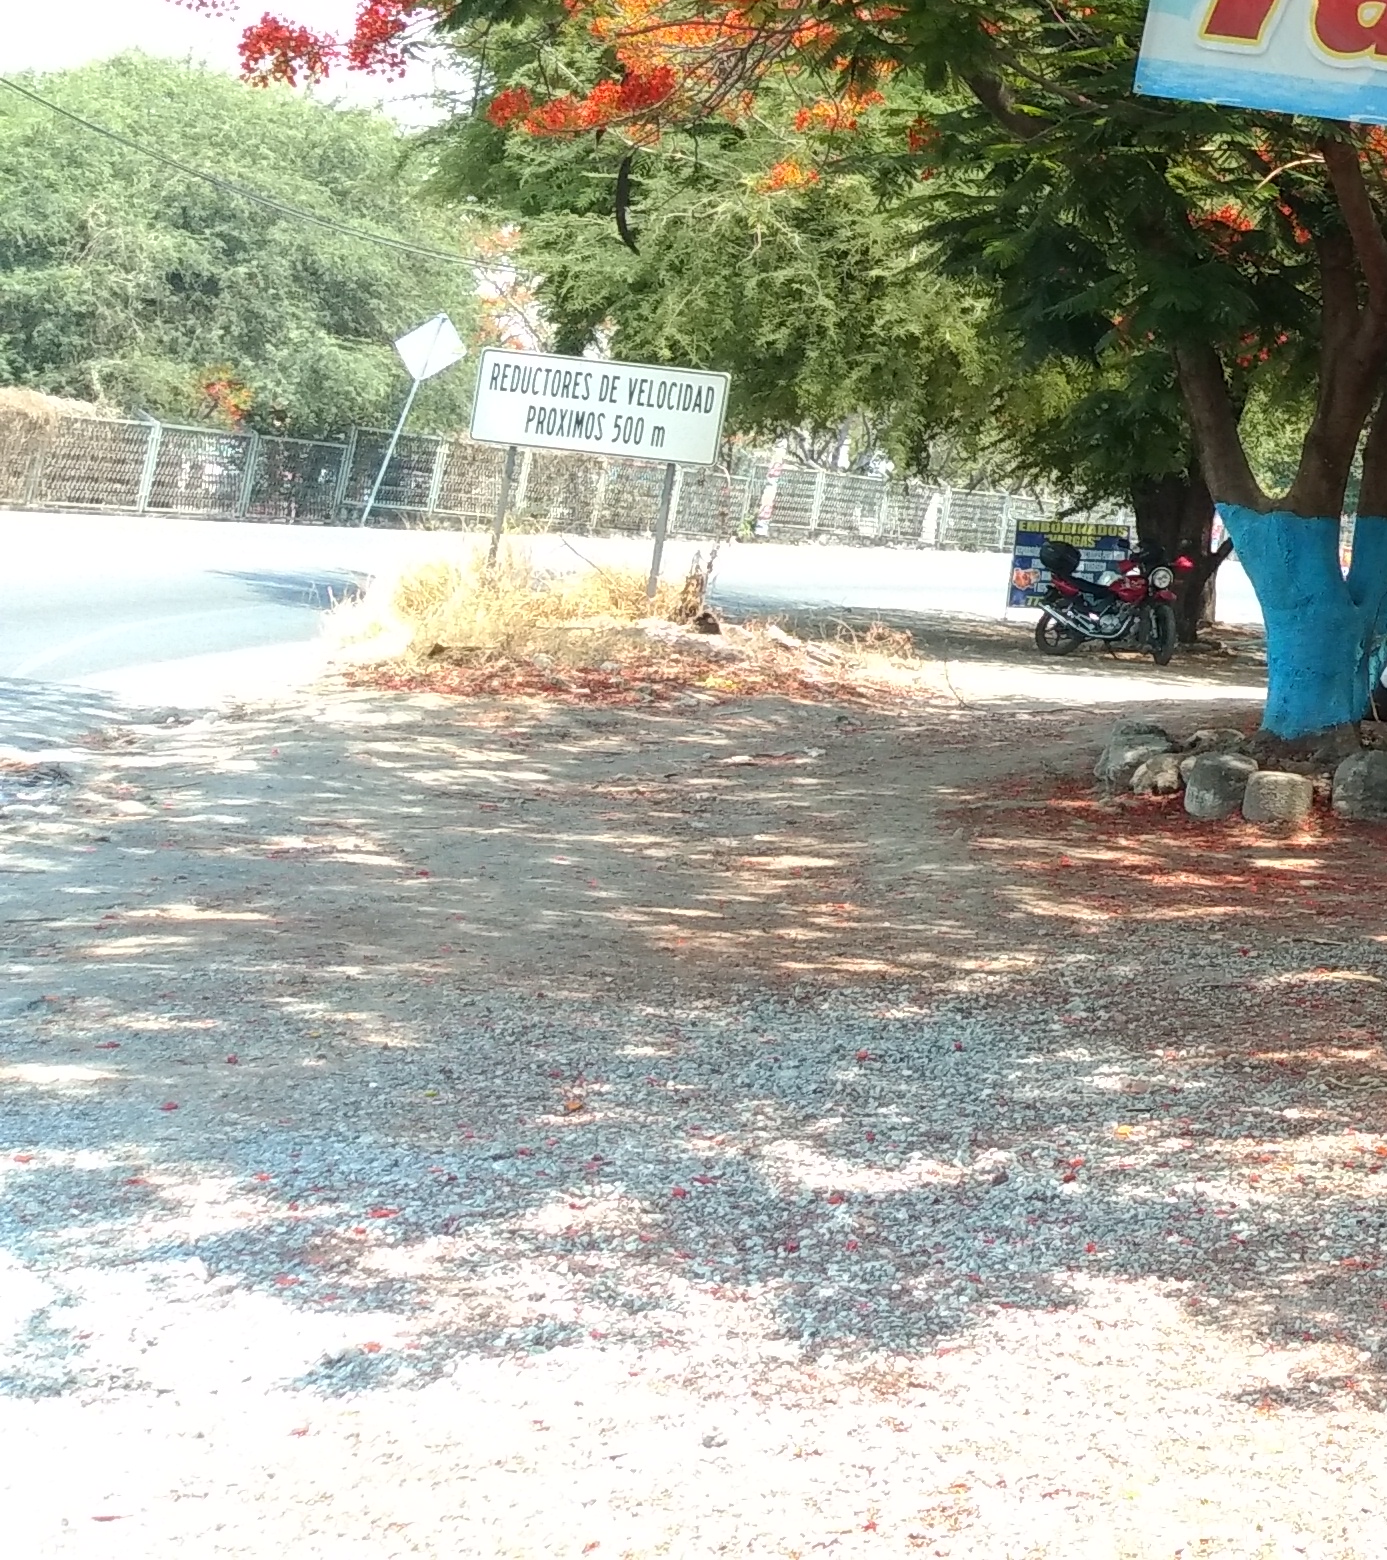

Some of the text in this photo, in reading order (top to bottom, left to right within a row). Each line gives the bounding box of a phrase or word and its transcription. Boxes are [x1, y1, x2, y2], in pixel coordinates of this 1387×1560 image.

[489, 362, 715, 414] REDUCTORES DE VELOCIDAD
[524, 405, 666, 448] PROXIMOS 500 m
